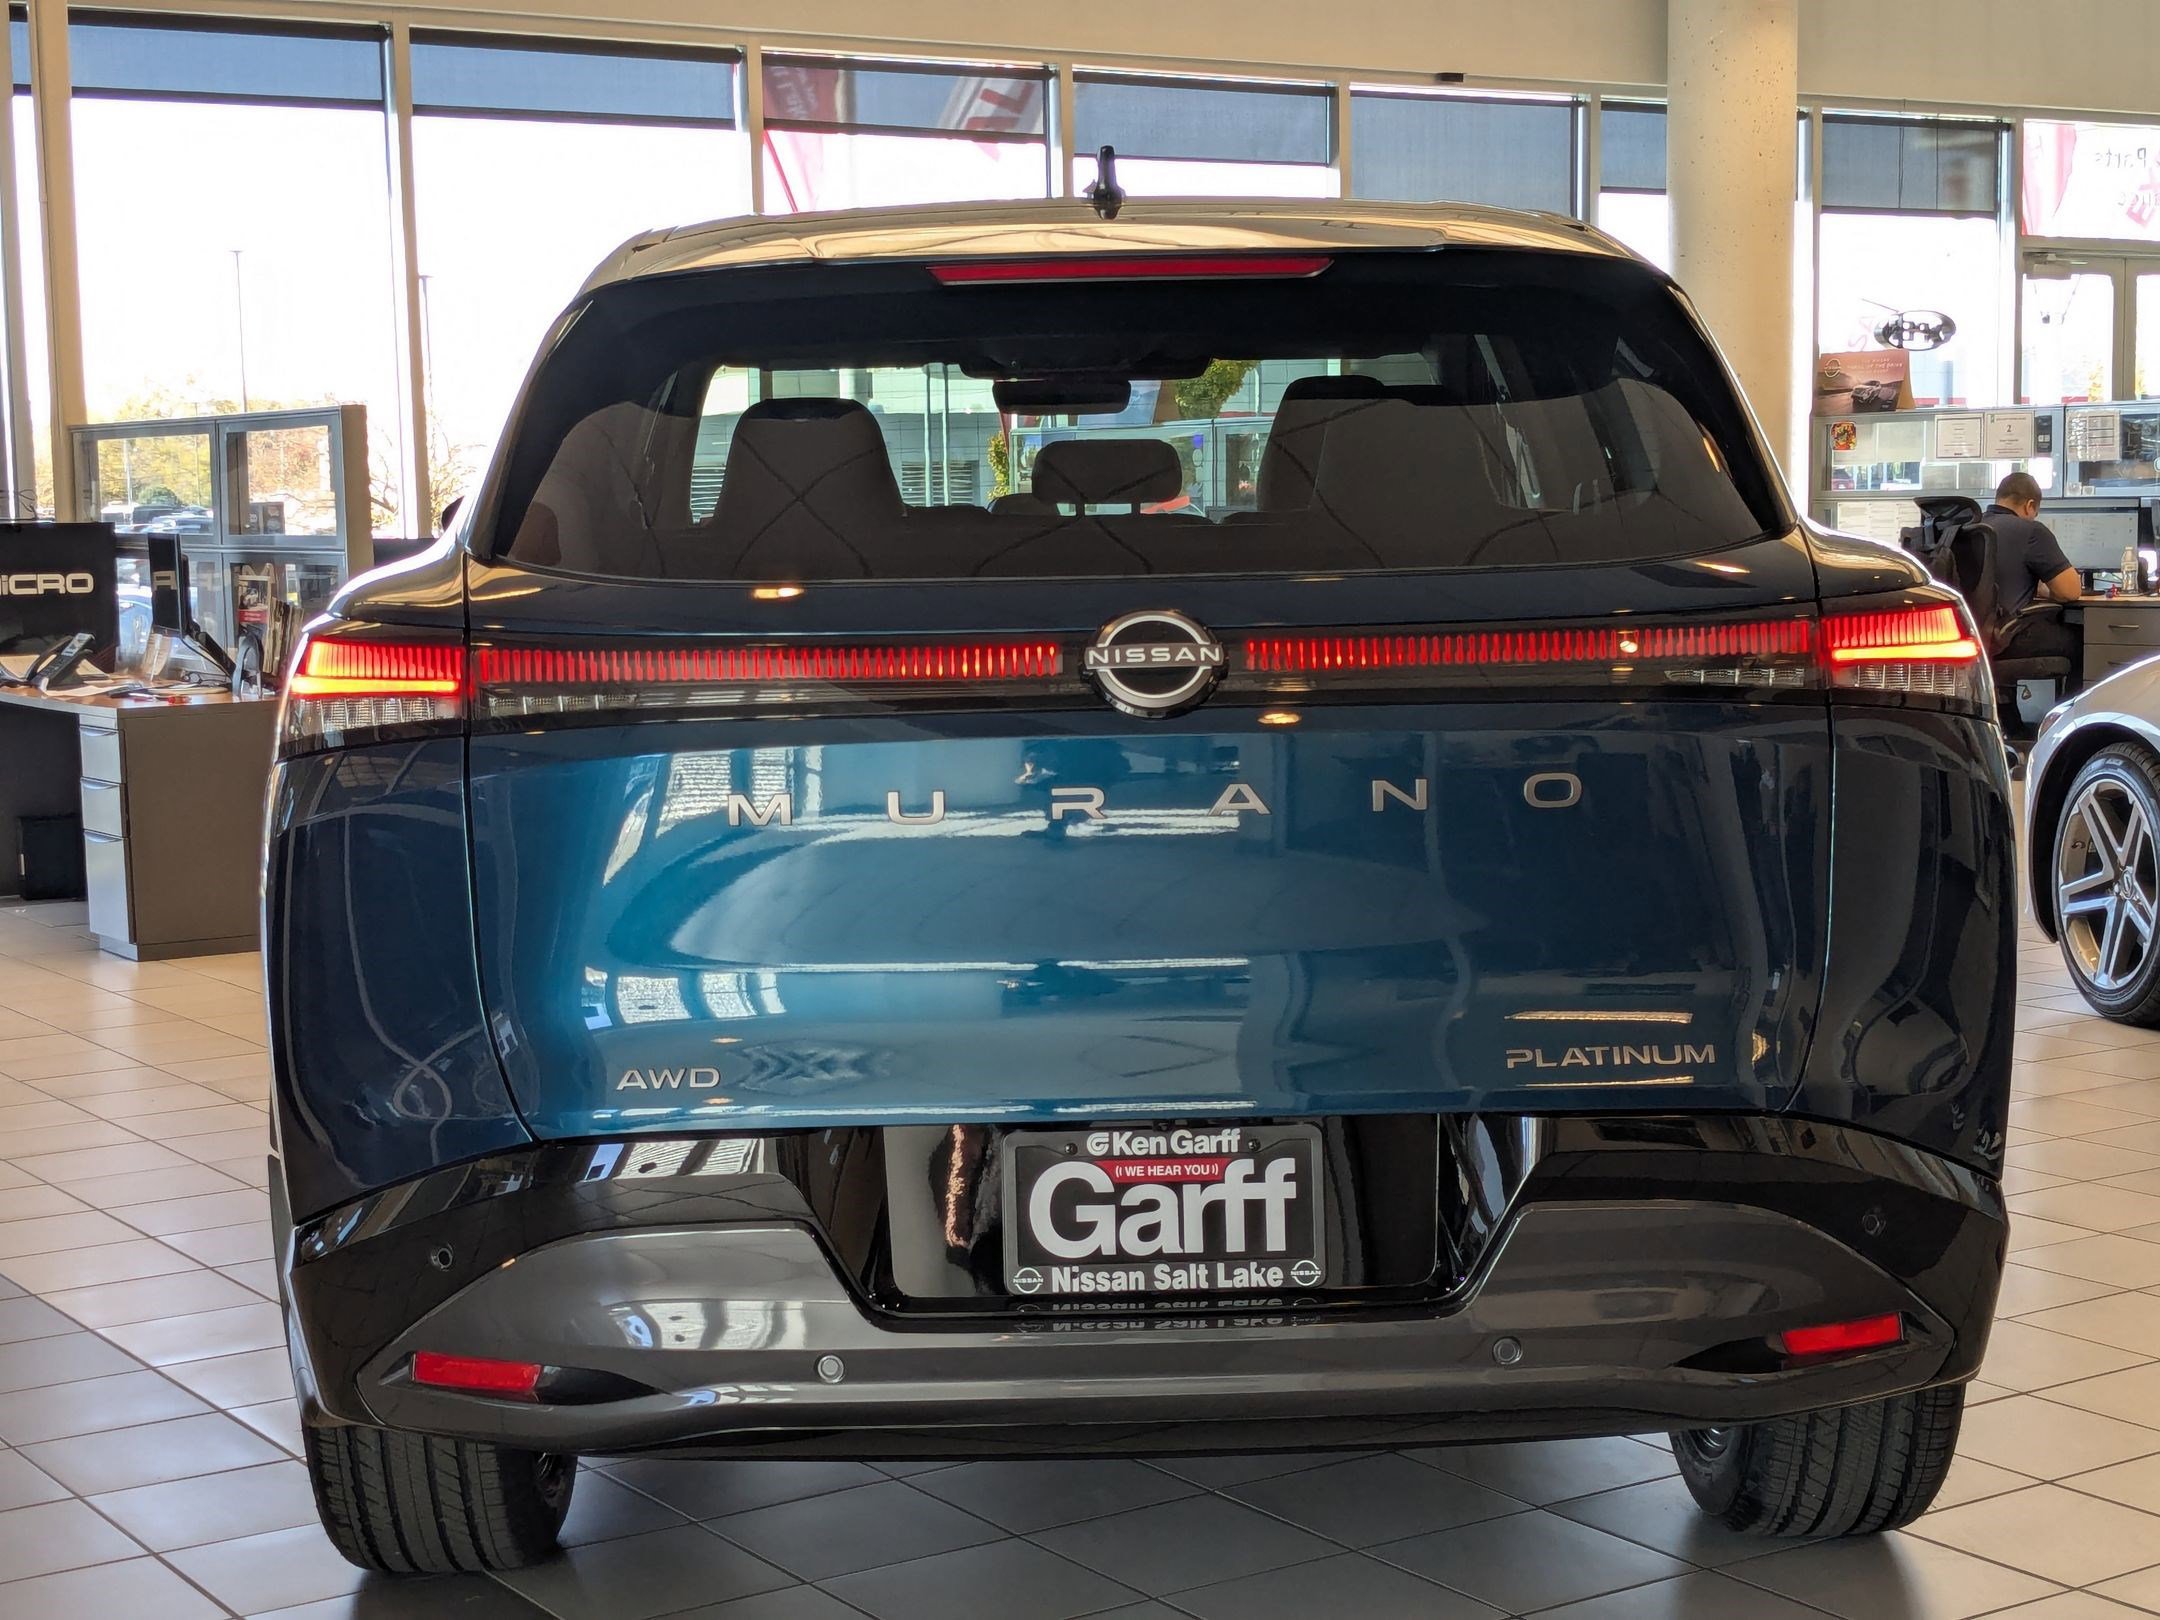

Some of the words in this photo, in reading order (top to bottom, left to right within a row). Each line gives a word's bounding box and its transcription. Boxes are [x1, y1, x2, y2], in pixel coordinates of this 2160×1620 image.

[0, 572, 94, 596] iCRO
[1088, 646, 1221, 665] NISSAN
[727, 772, 1582, 827] MURANO
[1505, 1044, 1716, 1069] PLATINUM
[616, 1067, 721, 1091] AWD
[1112, 1131, 1167, 1156] Ken
[1170, 1128, 1241, 1155] Garff
[1124, 1165, 1145, 1177] WE
[1147, 1164, 1182, 1176] HEAR
[1185, 1163, 1210, 1175] YOU
[1029, 1157, 1297, 1259] Garff
[1051, 1265, 1145, 1293] Nissan
[1153, 1263, 1209, 1291] Salt
[1216, 1261, 1284, 1288] Lake
